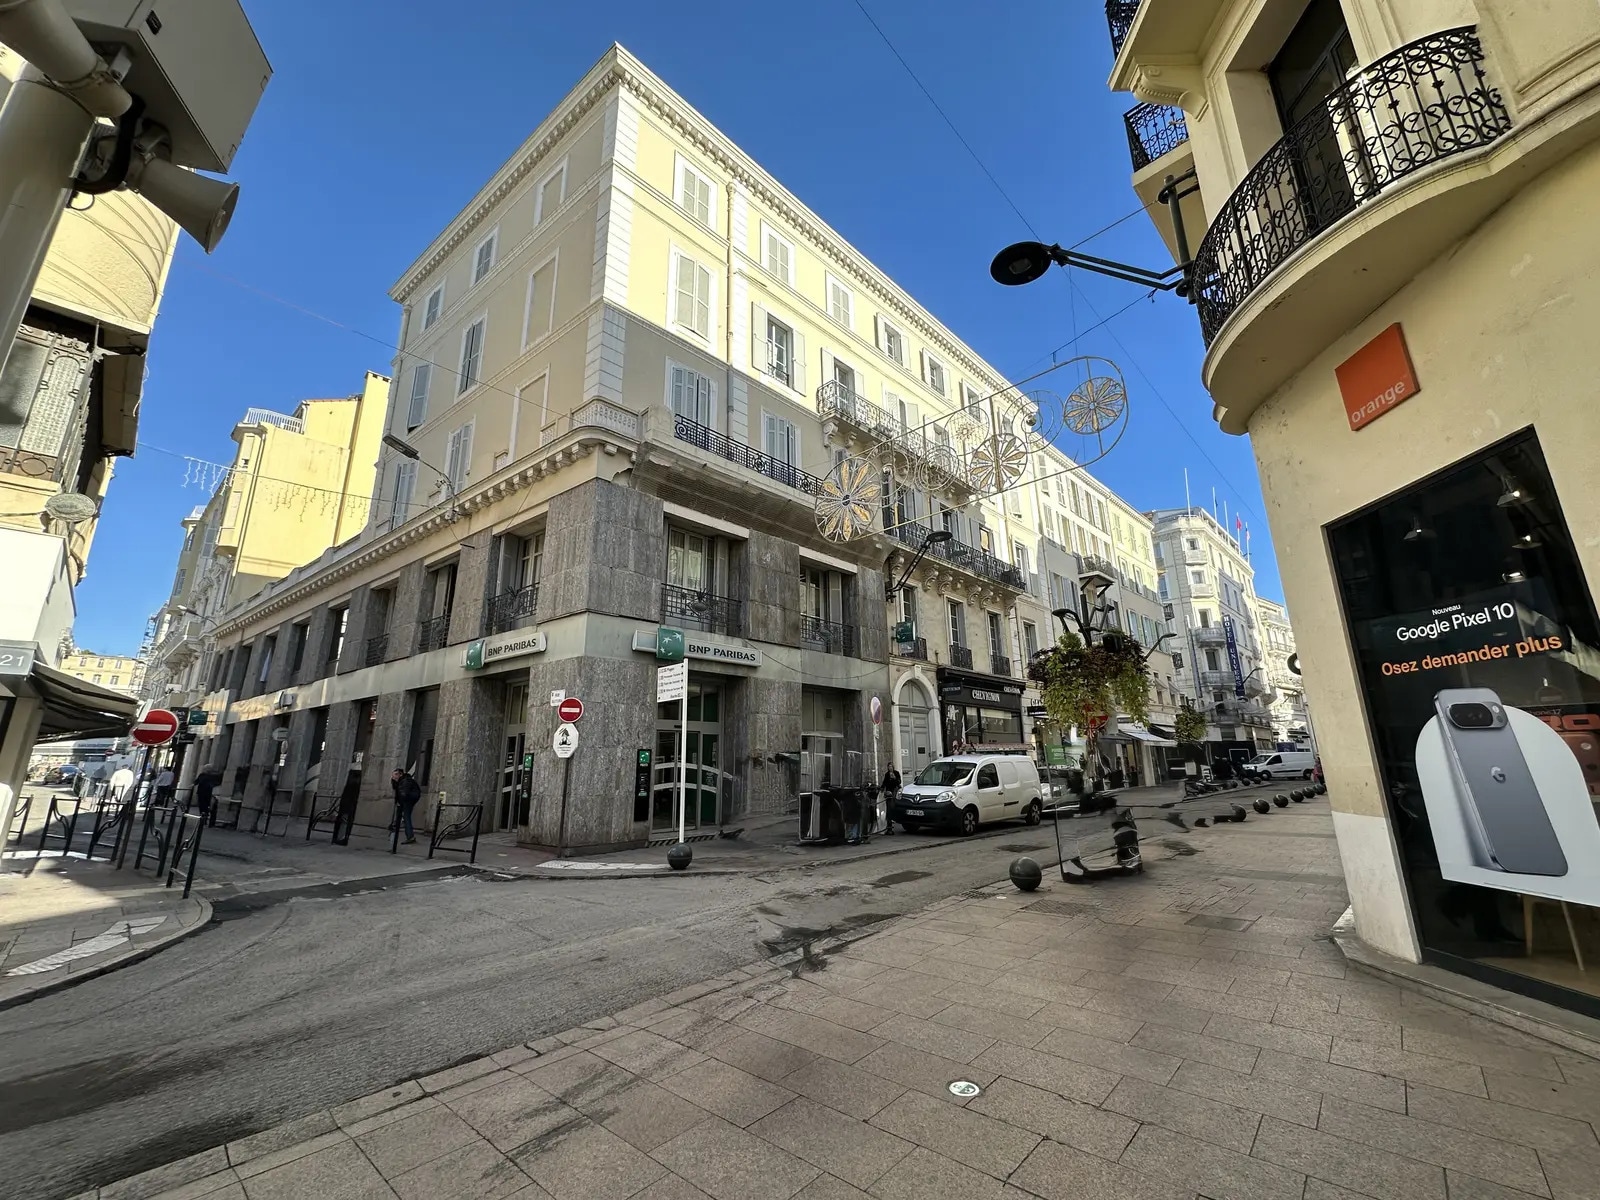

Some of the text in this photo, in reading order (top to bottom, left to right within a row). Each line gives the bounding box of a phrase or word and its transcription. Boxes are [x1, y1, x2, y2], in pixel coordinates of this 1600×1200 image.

[1351, 381, 1405, 423] orange
[1431, 604, 1461, 615] Nouveau
[1396, 602, 1515, 641] Google Pixel 10
[488, 638, 537, 657] BNP PARIBAS
[689, 644, 756, 661] BNP PARIBAS
[1381, 635, 1562, 676] Osez demander plus
[0, 654, 24, 667] 21
[1229, 647, 1242, 687] UNIVERS
[972, 689, 1000, 703] CHEVIGNON
